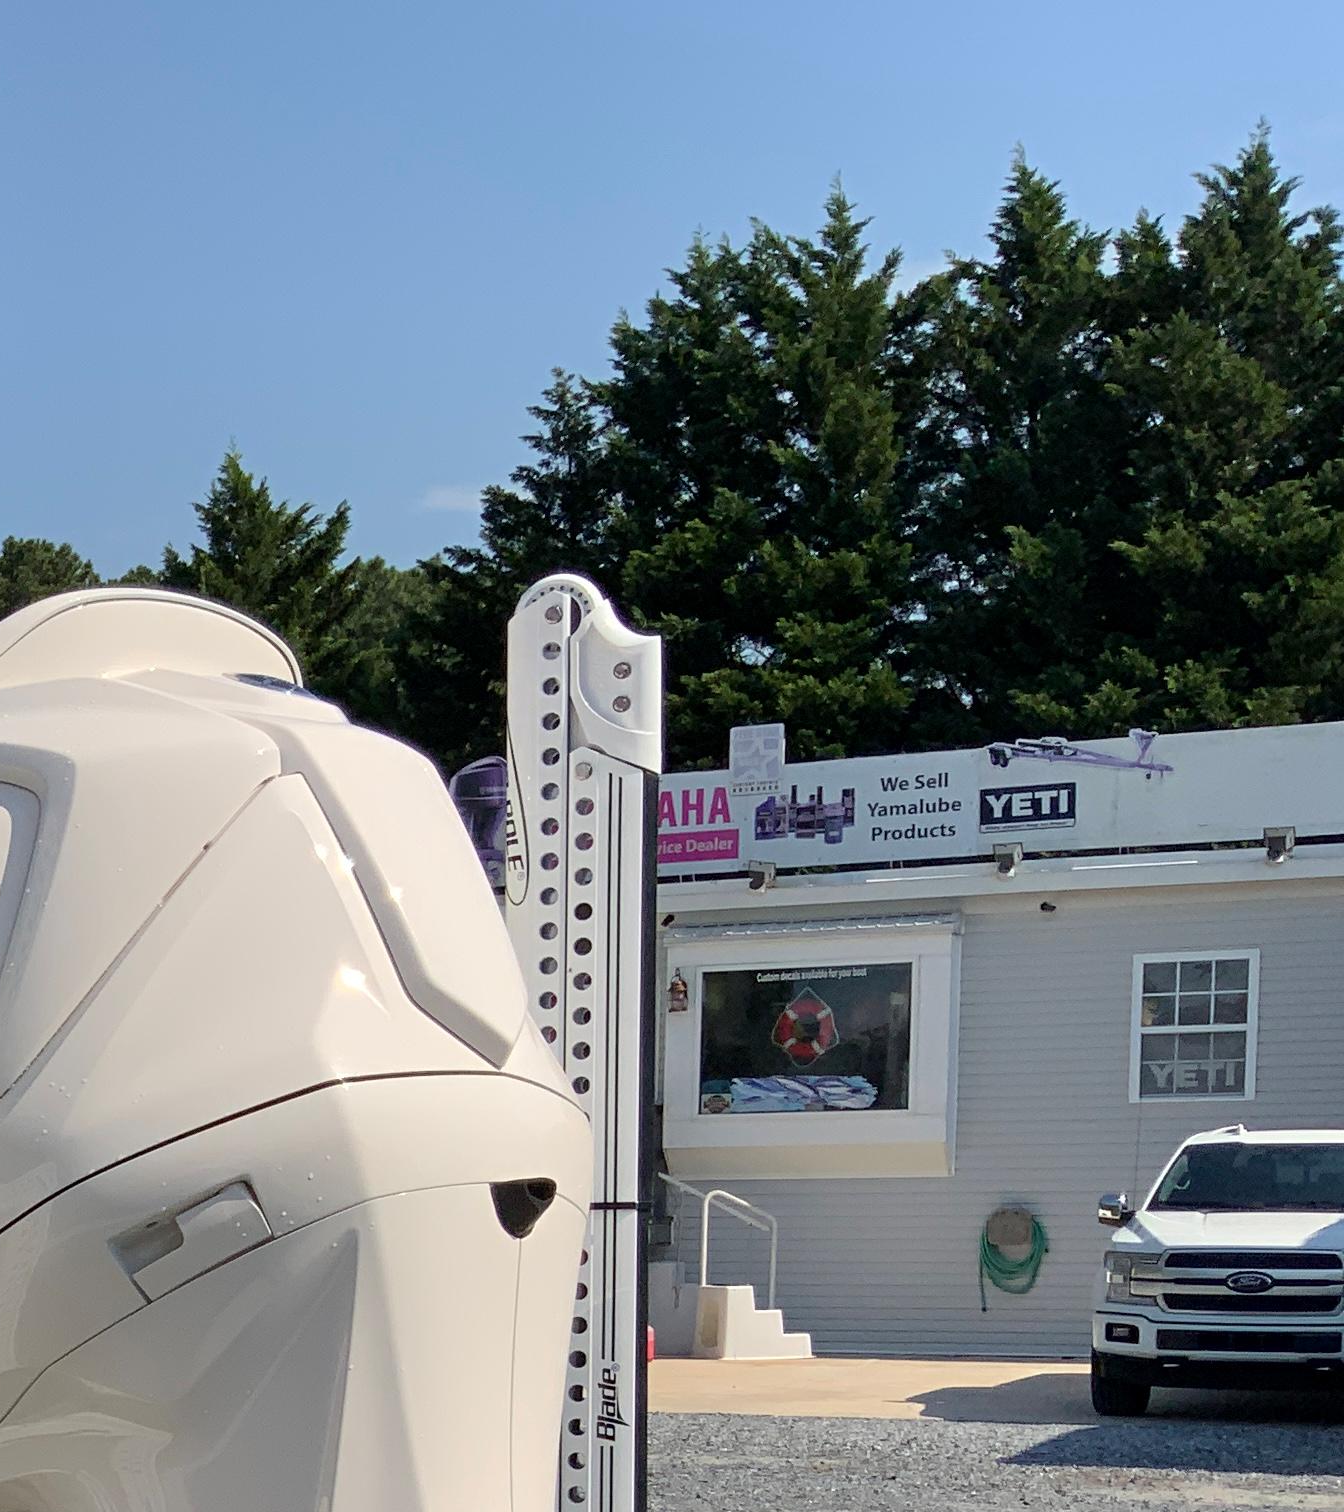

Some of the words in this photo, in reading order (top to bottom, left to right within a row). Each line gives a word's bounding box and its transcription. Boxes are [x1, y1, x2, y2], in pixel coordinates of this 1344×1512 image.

[880, 775, 914, 793] We
[919, 771, 950, 791] Sell
[658, 786, 731, 828] AHA
[867, 796, 962, 818] Yamalube
[985, 789, 1072, 819] YETI
[686, 836, 735, 853] Dealer
[870, 823, 957, 843] Products
[1148, 1060, 1236, 1088] YETI
[596, 1367, 627, 1442] Blade
